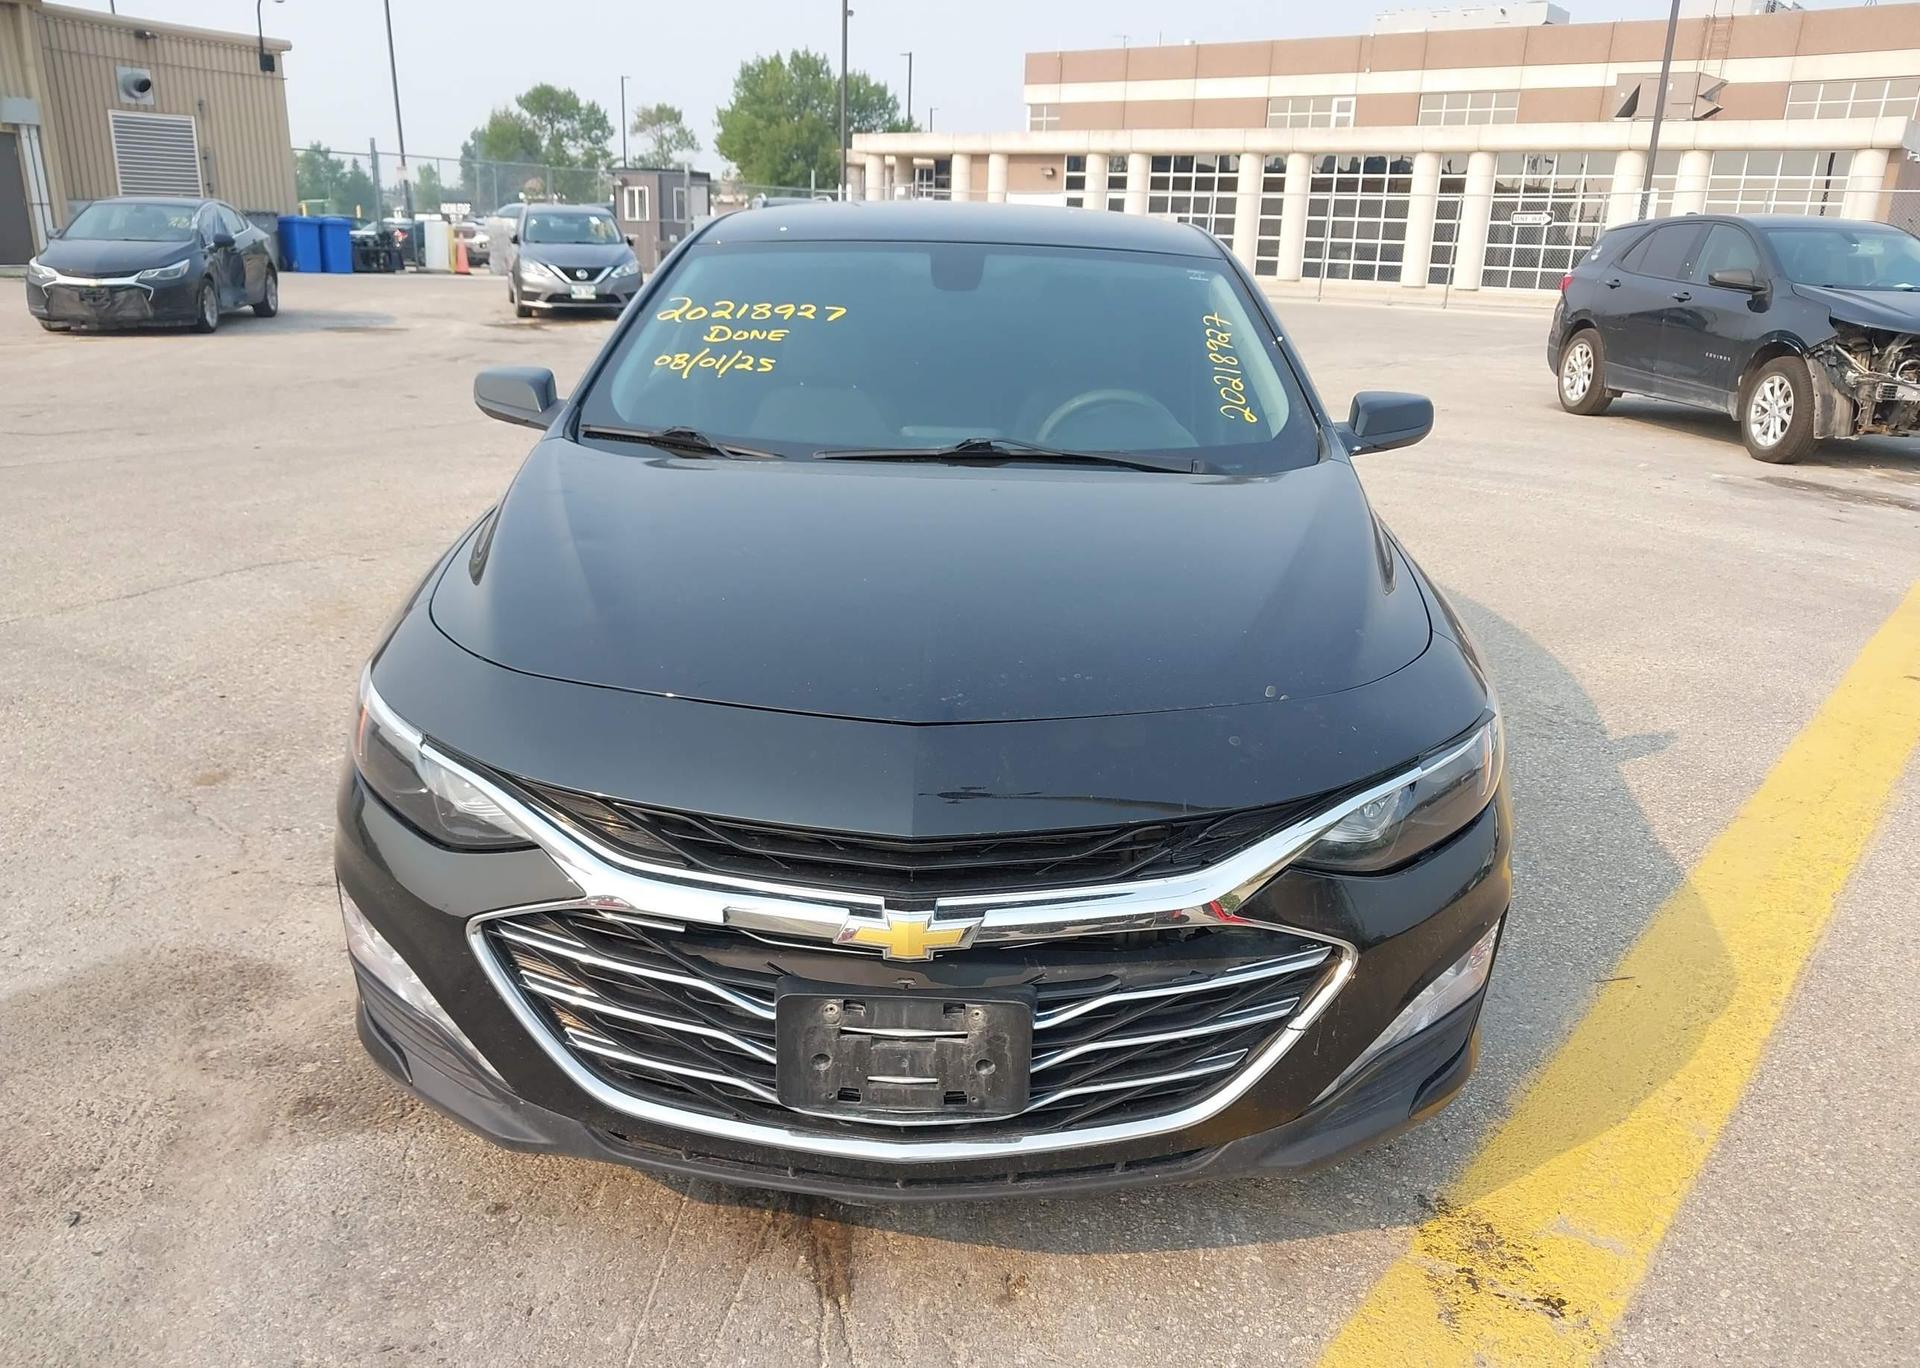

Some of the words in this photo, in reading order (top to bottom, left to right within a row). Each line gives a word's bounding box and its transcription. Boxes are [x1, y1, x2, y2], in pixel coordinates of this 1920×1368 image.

[656, 296, 847, 323] 20218927
[703, 325, 790, 343] DONE
[653, 348, 777, 380] 08/01/25
[1202, 311, 1258, 424] 20218927
